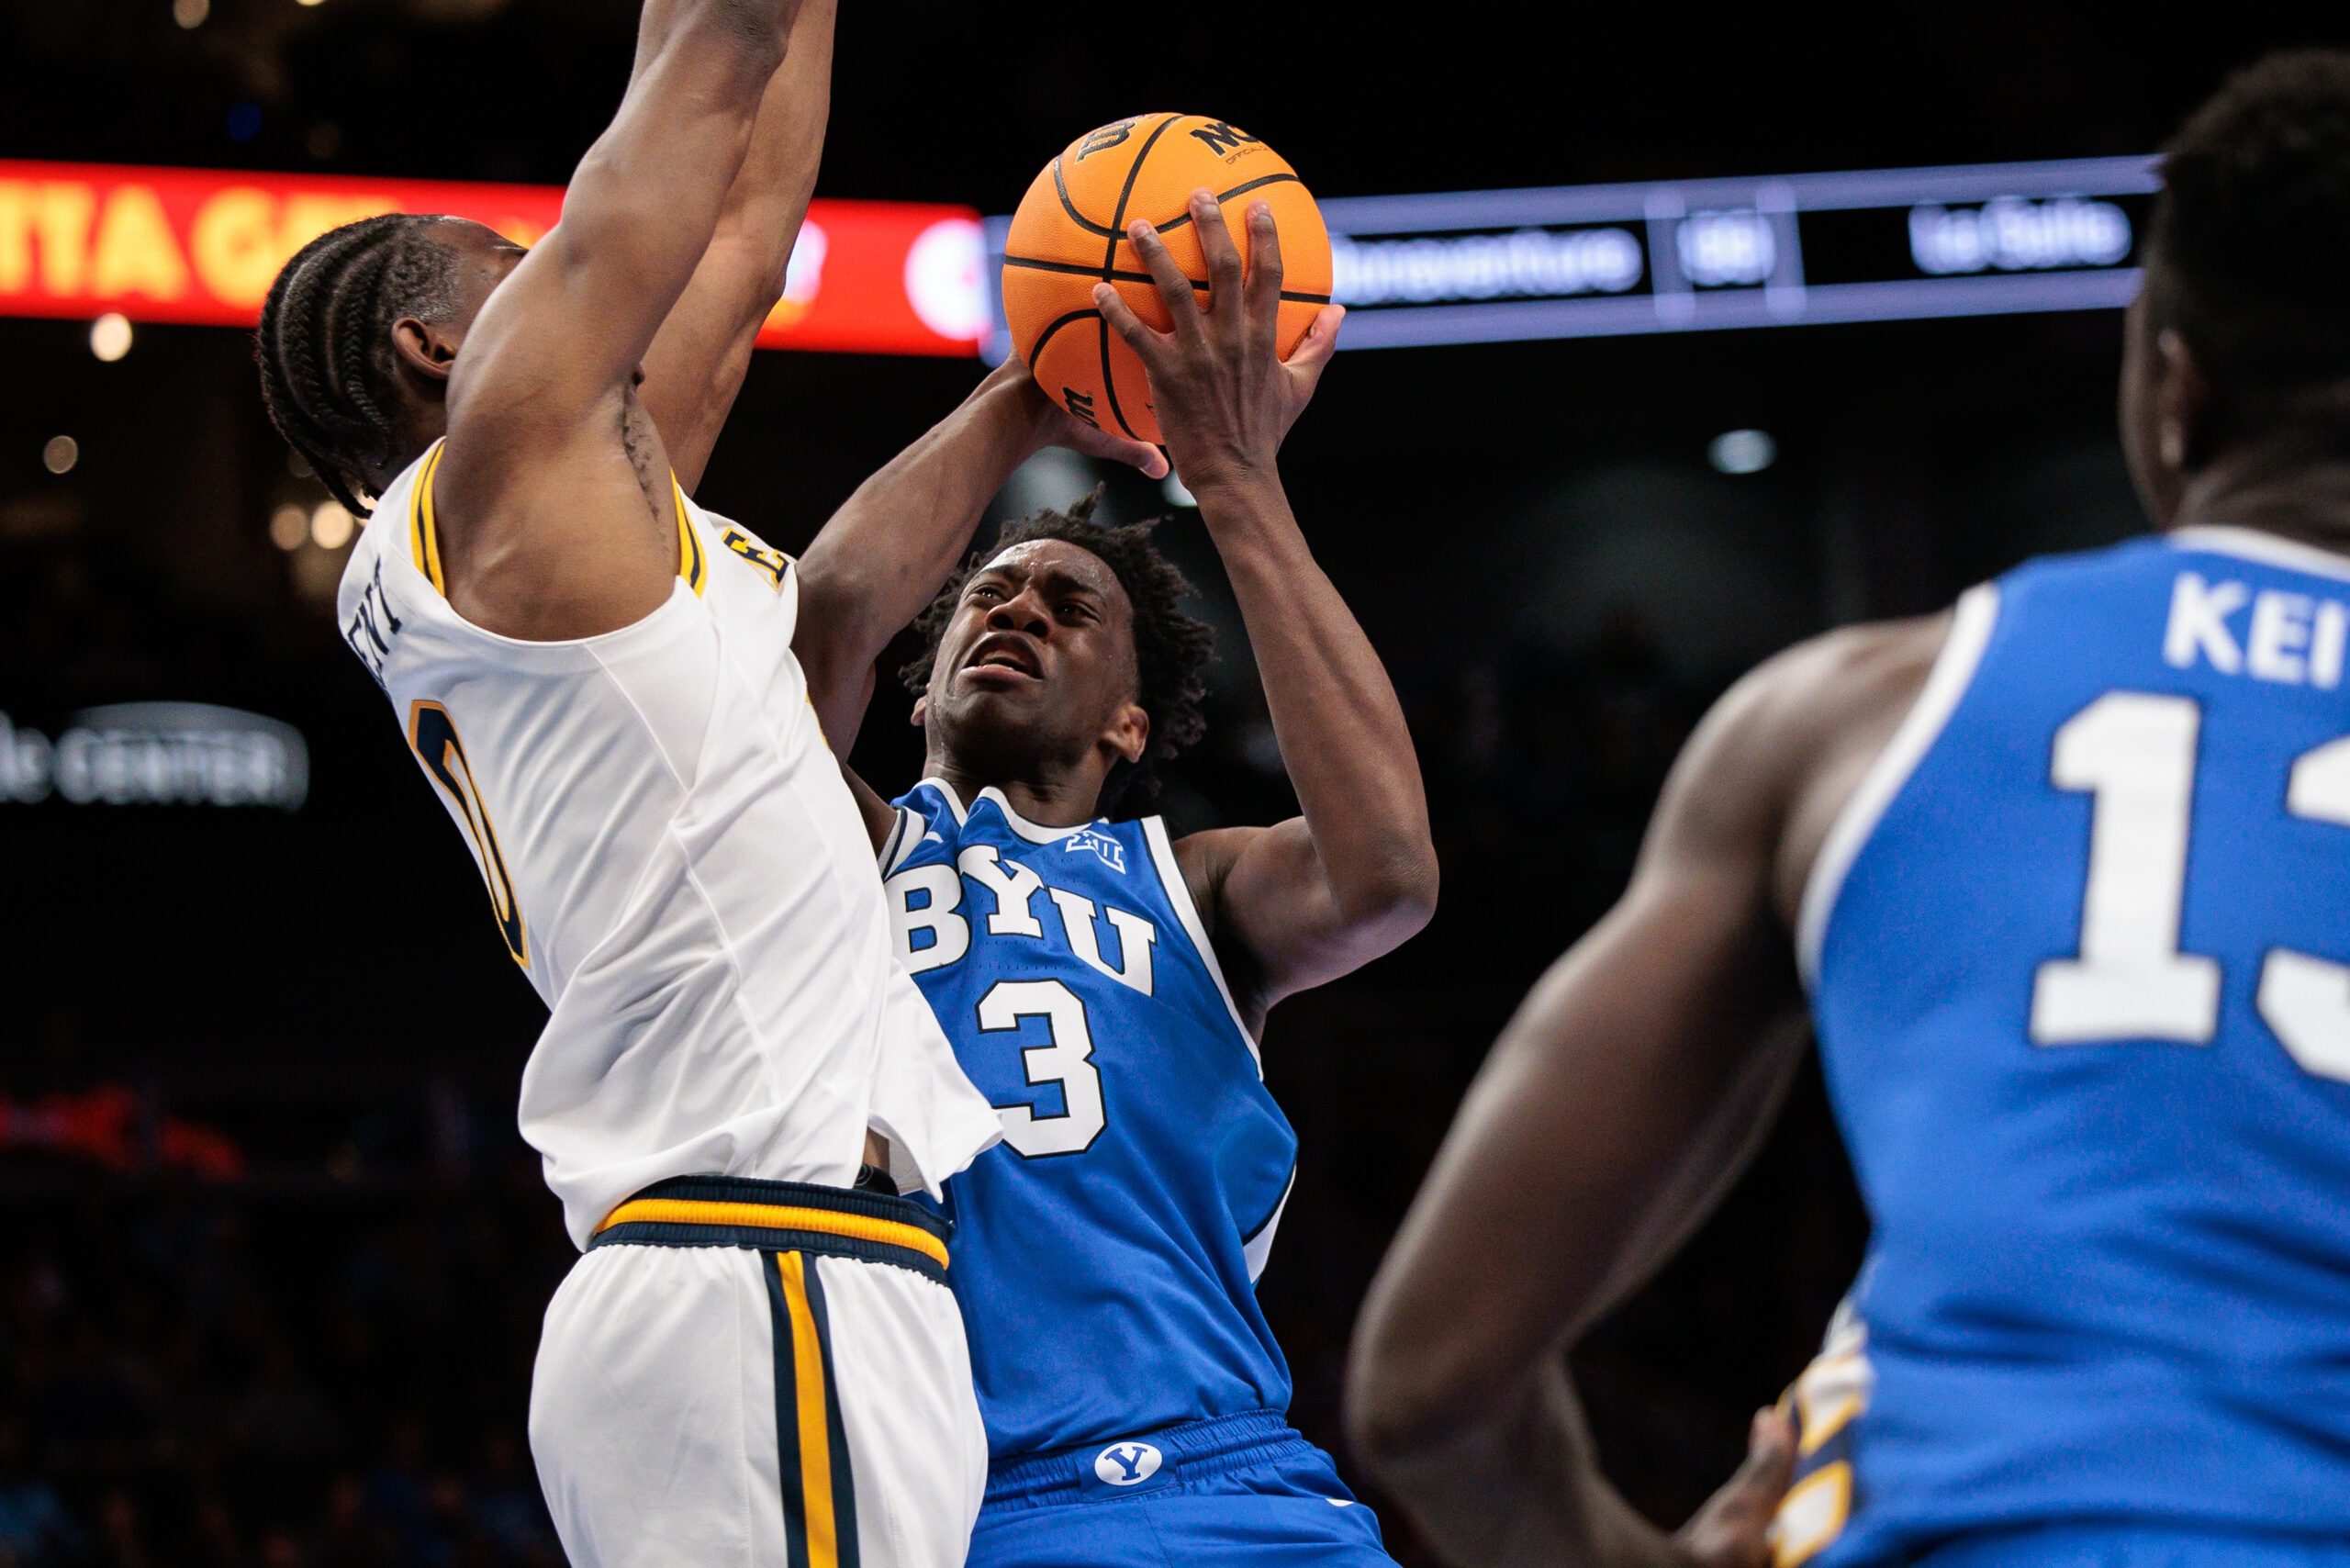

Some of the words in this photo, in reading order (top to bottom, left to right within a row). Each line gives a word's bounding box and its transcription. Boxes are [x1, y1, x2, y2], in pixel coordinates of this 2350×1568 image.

[55, 725, 290, 806] CENTER
[882, 843, 1157, 998] BYU
[975, 977, 1108, 1159] 3
[1103, 1444, 1148, 1483] Y
